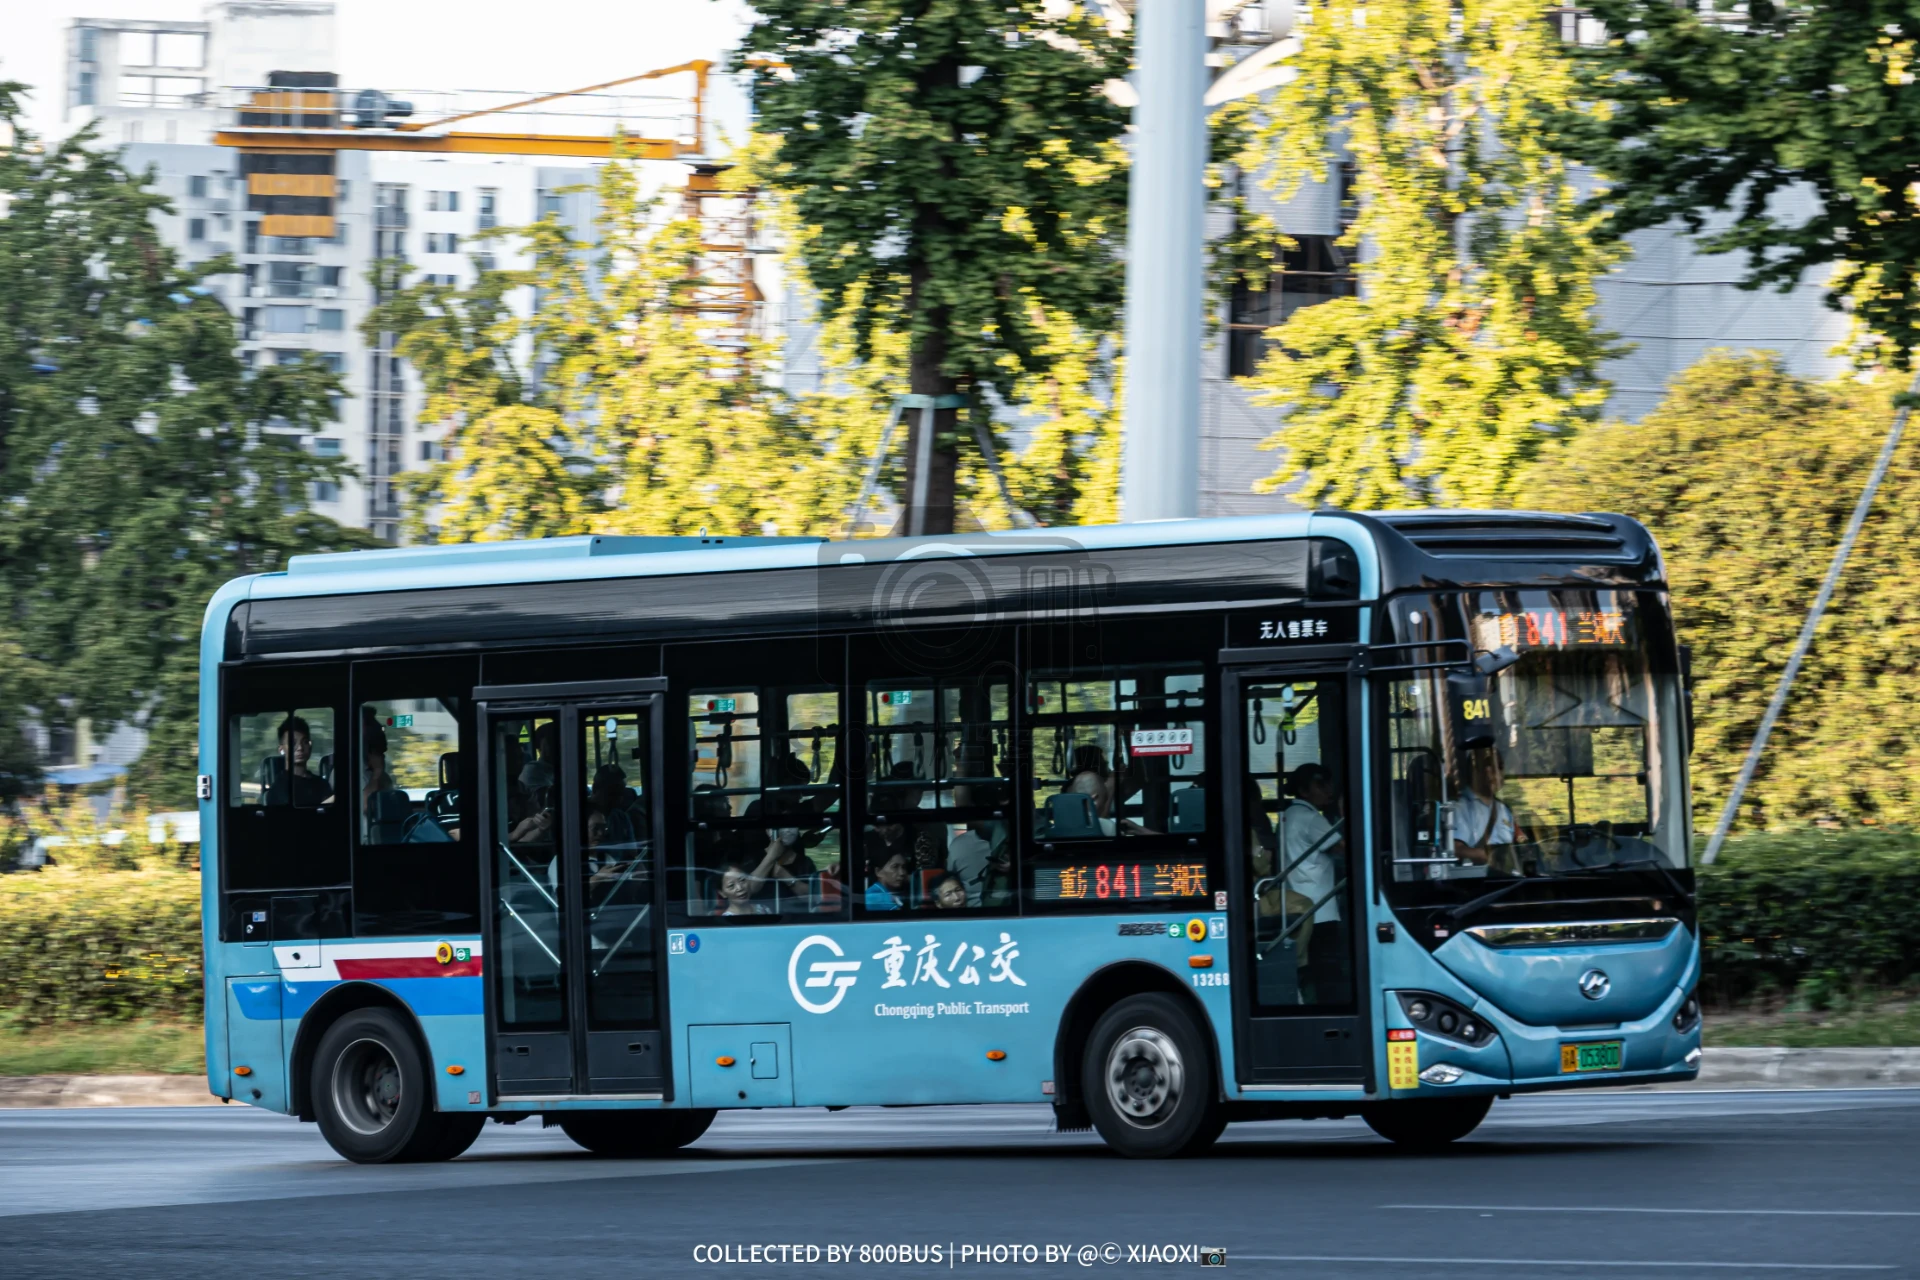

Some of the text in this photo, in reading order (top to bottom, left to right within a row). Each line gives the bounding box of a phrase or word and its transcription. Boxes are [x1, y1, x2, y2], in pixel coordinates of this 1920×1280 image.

[1526, 611, 1568, 646] 841
[1463, 698, 1491, 720] 841
[1095, 864, 1141, 899] 841
[872, 932, 1027, 989] 重庆公交
[1192, 972, 1230, 987] 13268
[874, 1001, 1030, 1020] Chongqing Public Transport
